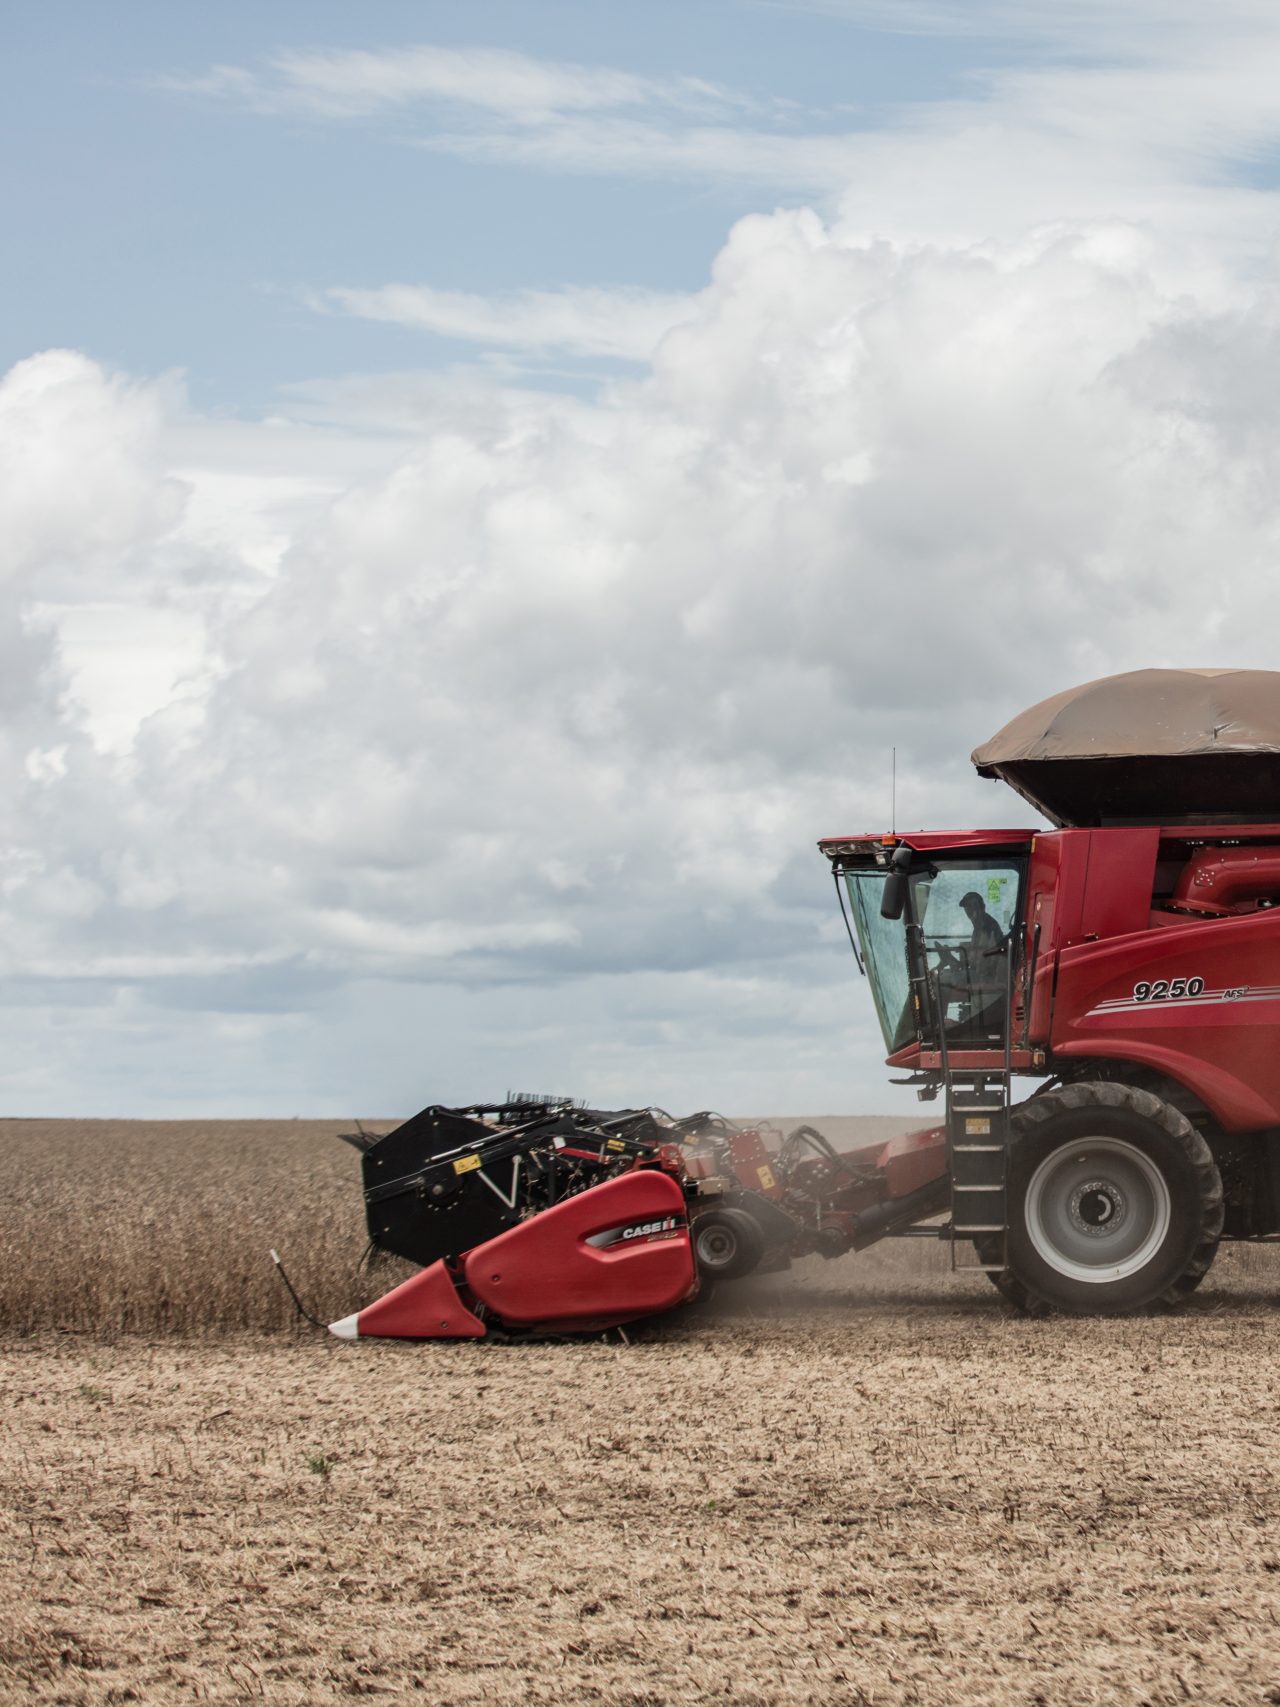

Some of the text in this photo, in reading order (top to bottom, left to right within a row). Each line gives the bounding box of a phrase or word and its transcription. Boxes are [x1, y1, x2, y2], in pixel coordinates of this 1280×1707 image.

[1134, 976, 1245, 1001] 9250 AFS
[622, 1221, 662, 1239] CASE
